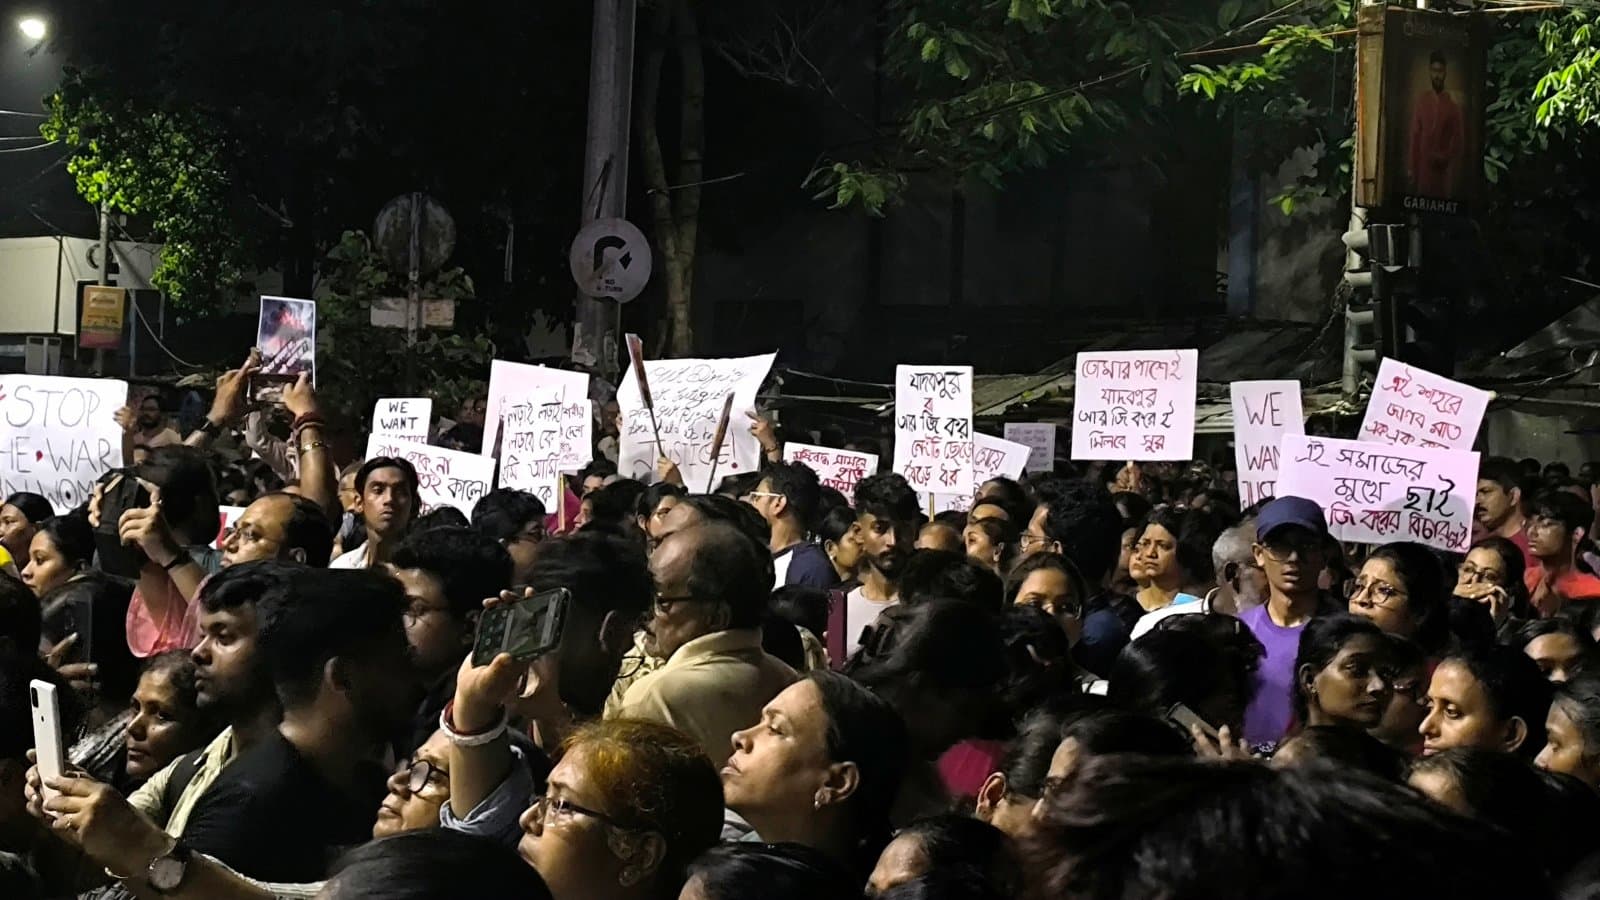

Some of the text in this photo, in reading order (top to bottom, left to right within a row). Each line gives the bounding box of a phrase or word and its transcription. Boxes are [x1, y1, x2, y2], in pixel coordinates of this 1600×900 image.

[1403, 196, 1458, 215] GARIAHAT
[1082, 350, 1183, 380] তোমার পাশেই
[909, 371, 966, 400] যাদবপুর
[1381, 367, 1413, 398] এই
[6, 385, 100, 428] STOP
[388, 401, 409, 414] WE
[1101, 388, 1158, 408] যাদবপুর
[1243, 392, 1283, 426] WE
[380, 417, 419, 430] WANT
[897, 409, 969, 439] আর জি কর
[1079, 409, 1107, 426] আর
[1111, 406, 1128, 427] জি
[1387, 402, 1426, 429] জাগব
[0, 436, 112, 474] HE WAR
[1089, 430, 1165, 453] মিলবে সুর
[1244, 444, 1281, 472] WAN
[1296, 440, 1428, 481] এই সমাজের
[37, 479, 95, 509] WOM
[447, 478, 488, 501] কালো
[1334, 475, 1456, 517] মুখে ছাই
[1329, 501, 1357, 527] জি
[1408, 511, 1450, 541] বিচার
